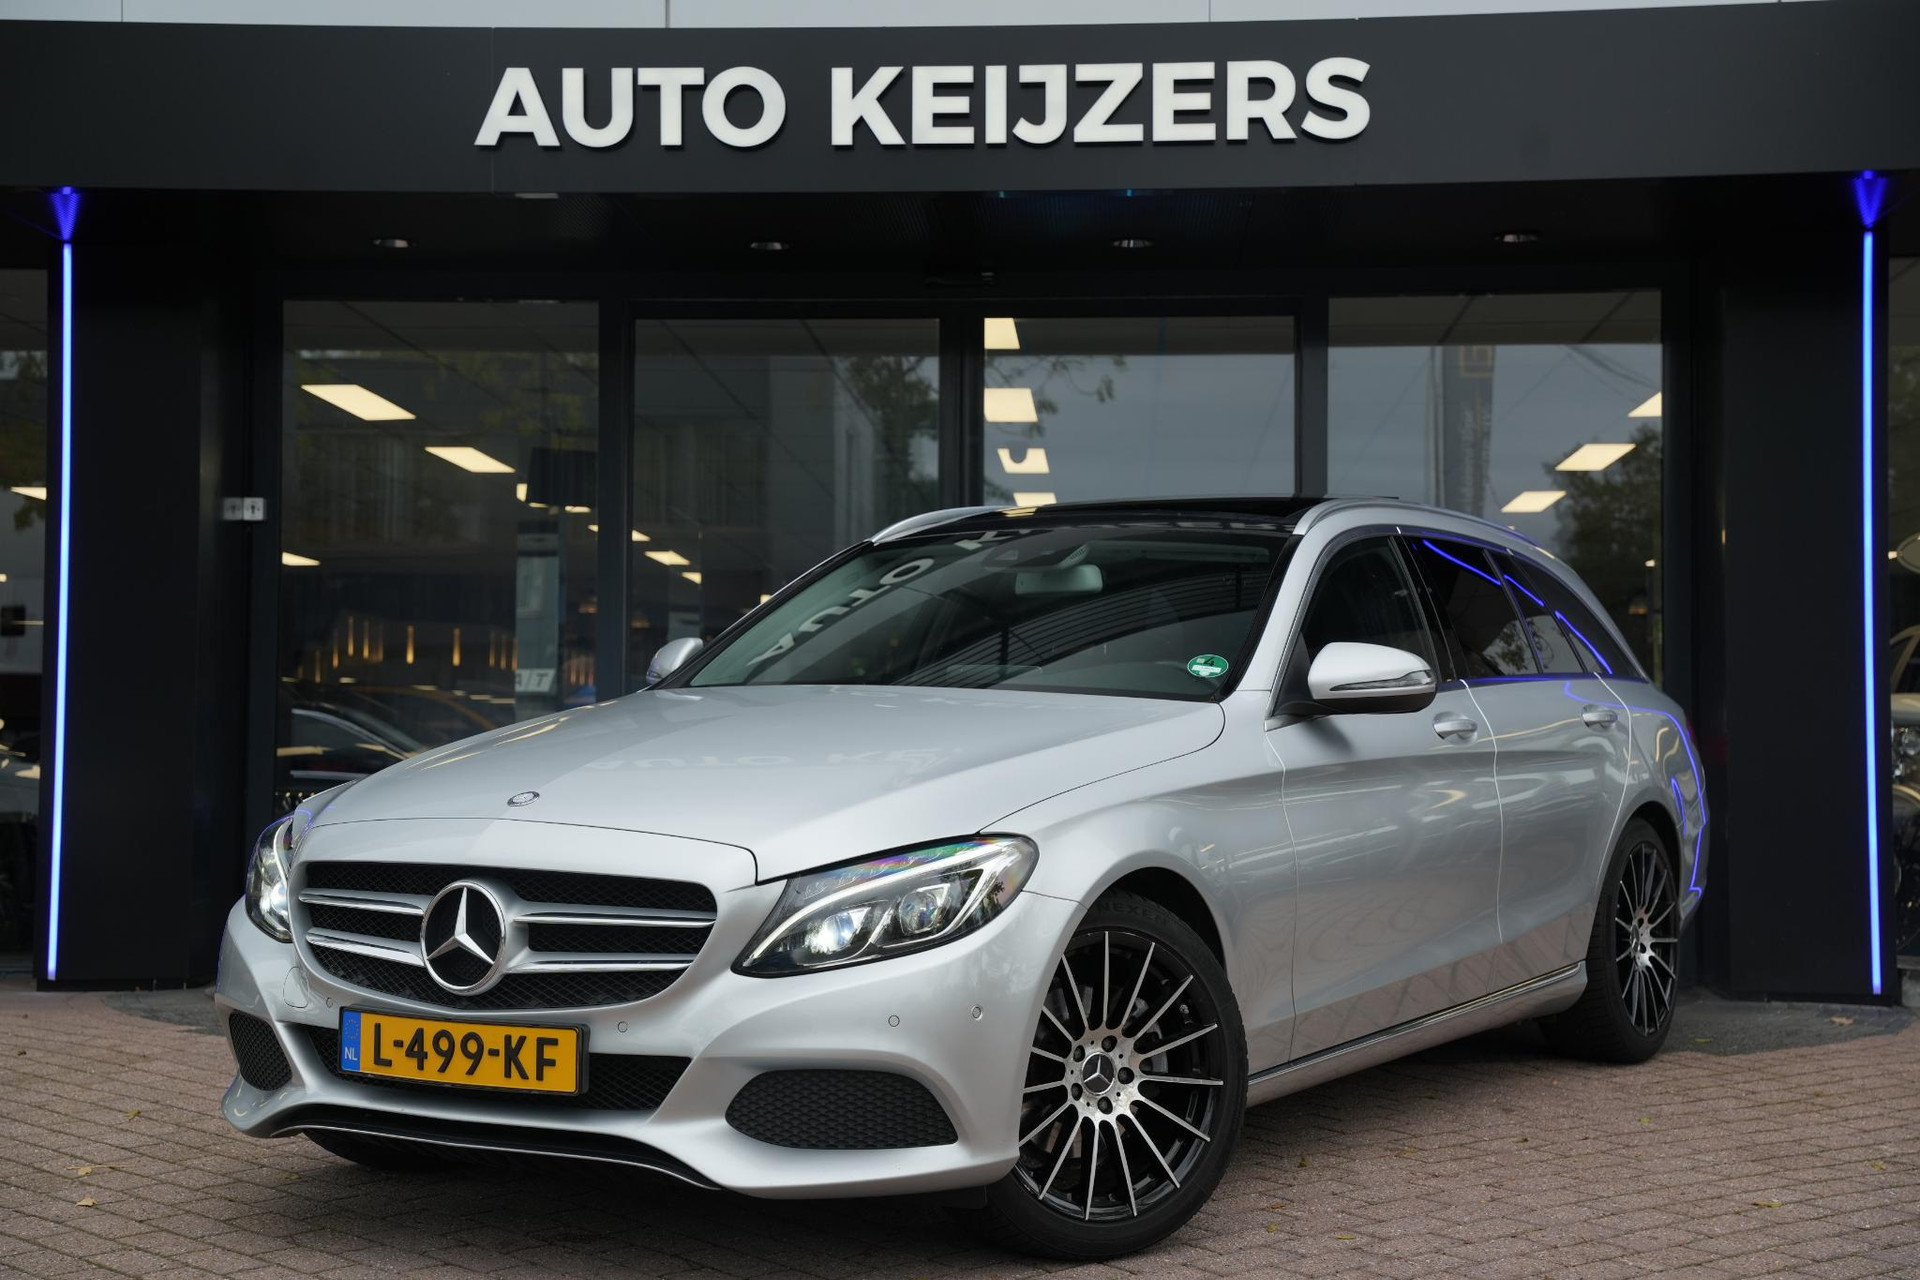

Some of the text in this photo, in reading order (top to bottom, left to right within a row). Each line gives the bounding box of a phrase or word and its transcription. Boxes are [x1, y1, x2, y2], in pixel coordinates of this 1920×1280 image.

[474, 57, 1371, 147] AUTO KEIJZERS
[1097, 902, 1168, 927] NEXEN
[344, 1046, 358, 1062] NL
[373, 1022, 559, 1082] L-499-KF
